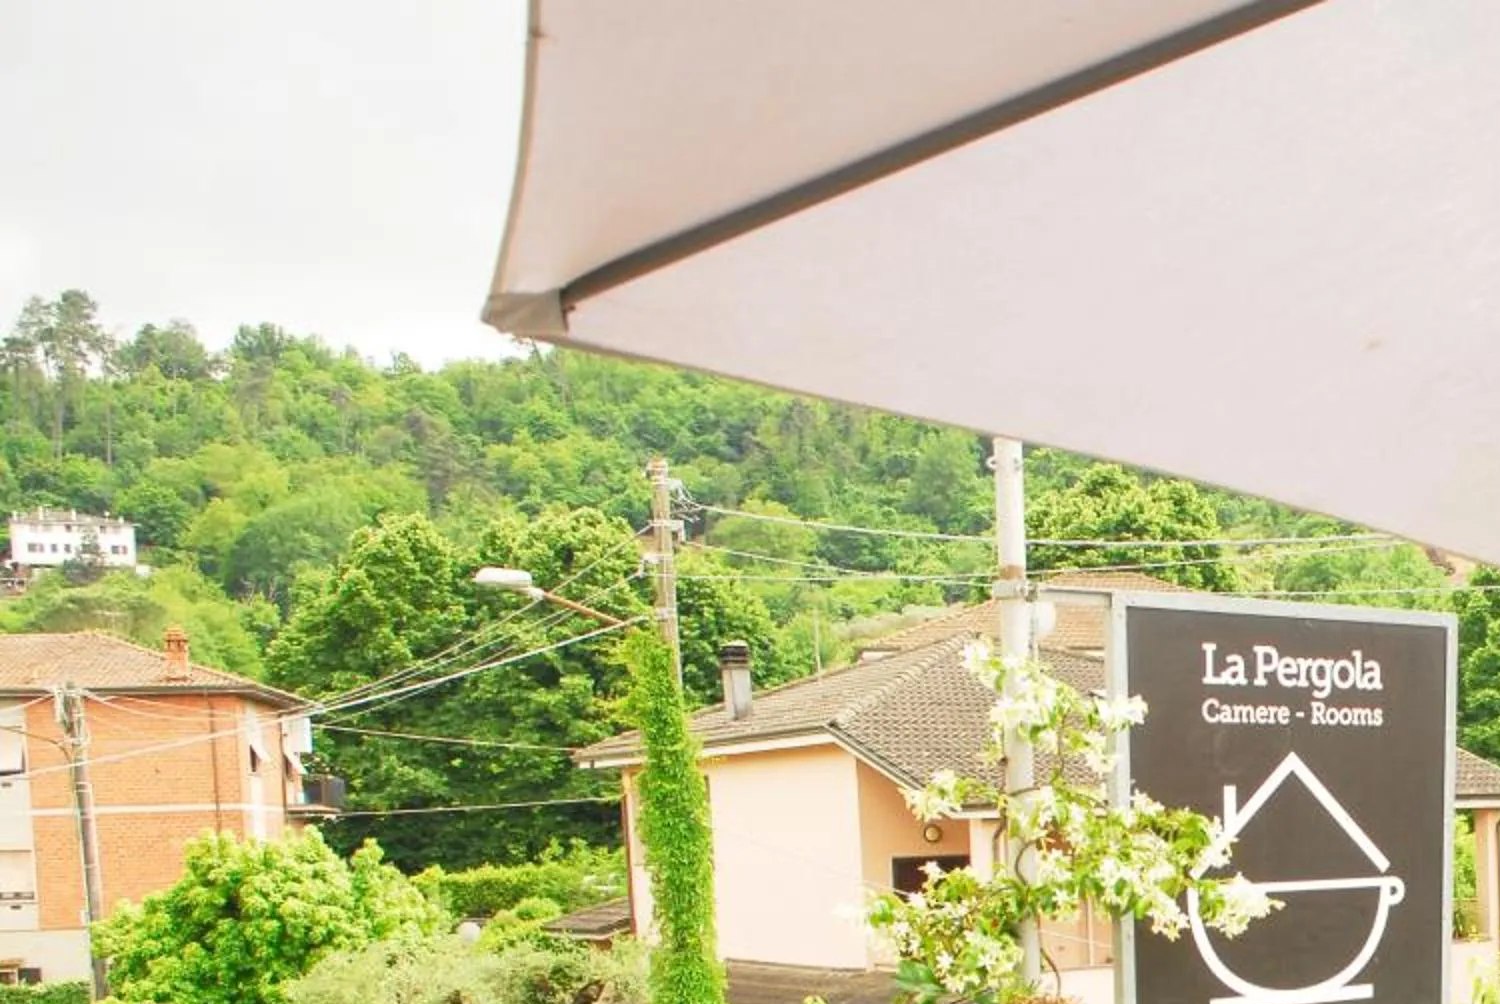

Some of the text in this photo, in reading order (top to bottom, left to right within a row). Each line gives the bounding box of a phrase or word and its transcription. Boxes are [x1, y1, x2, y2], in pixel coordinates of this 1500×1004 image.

[1201, 642, 1384, 699] La Pergola
[1201, 697, 1291, 726] Camere
[1309, 701, 1384, 728] Rooms
